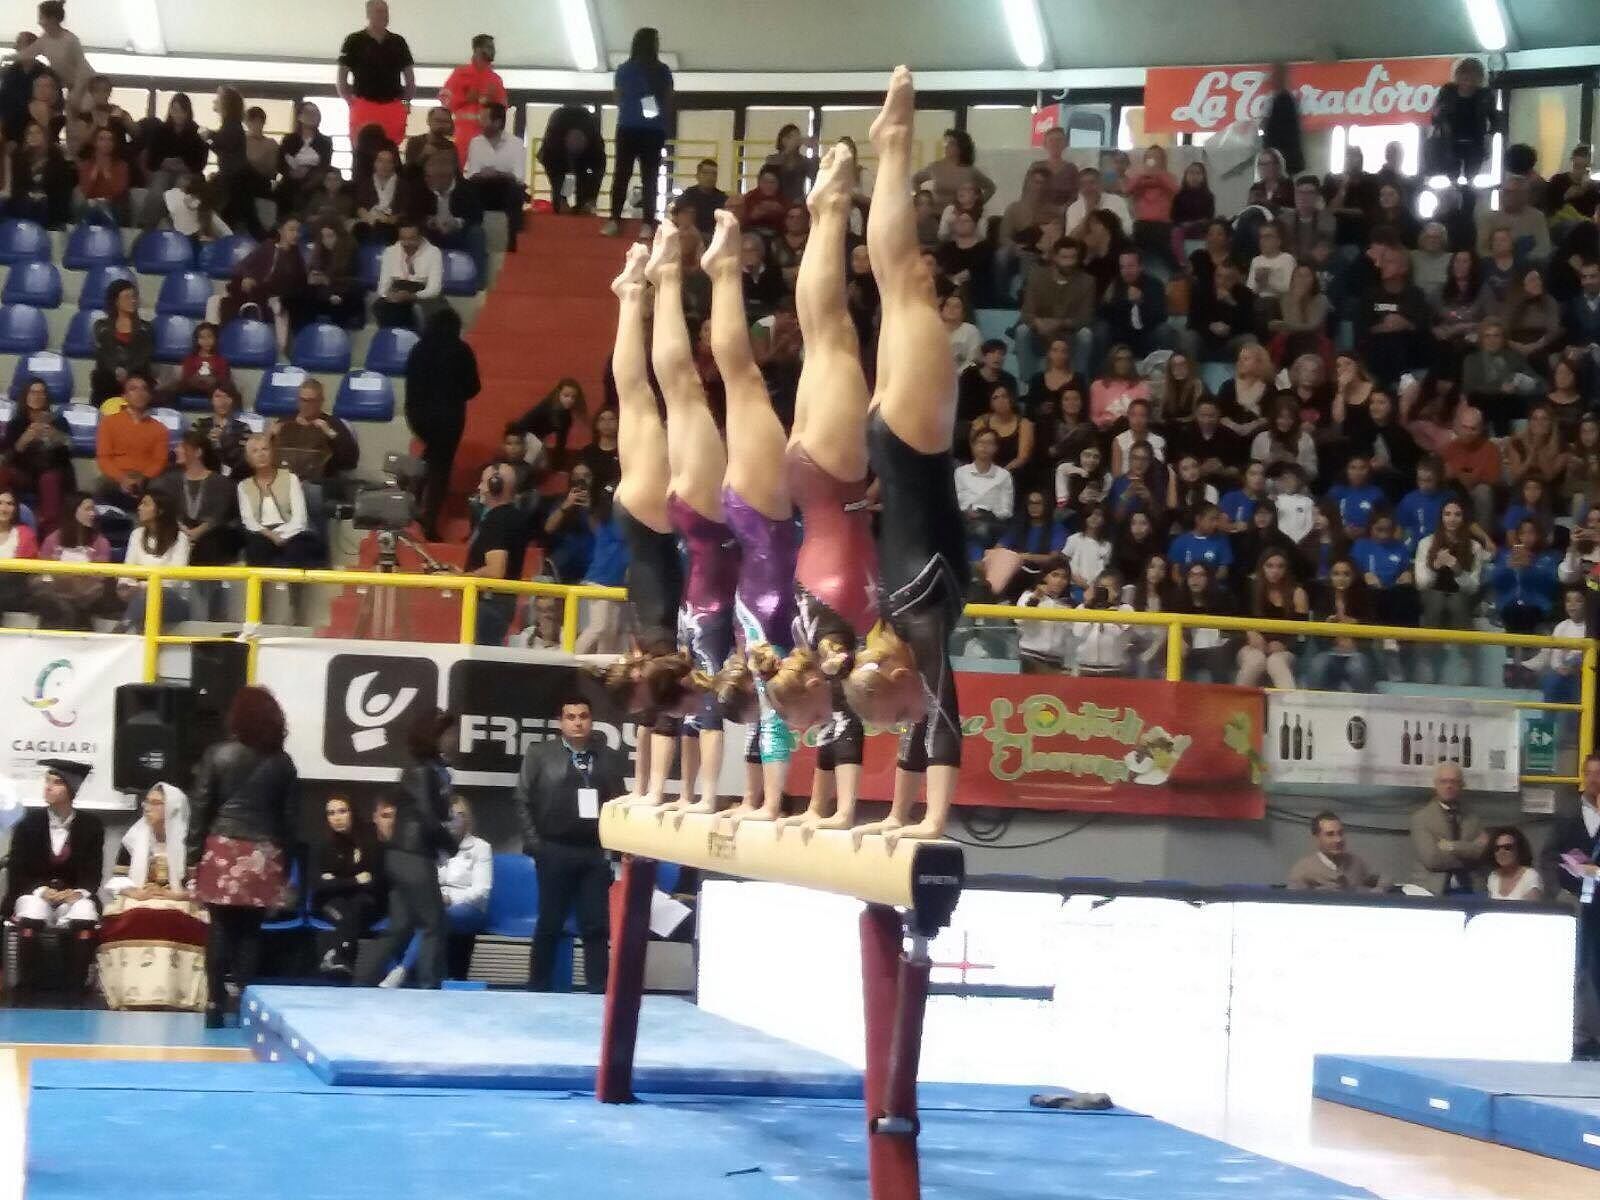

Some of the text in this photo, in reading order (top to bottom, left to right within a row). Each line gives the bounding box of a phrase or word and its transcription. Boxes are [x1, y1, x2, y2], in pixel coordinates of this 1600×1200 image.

[1171, 71, 1228, 127] La
[12, 739, 97, 753] CAGLIARI
[459, 714, 640, 761] FREDY
